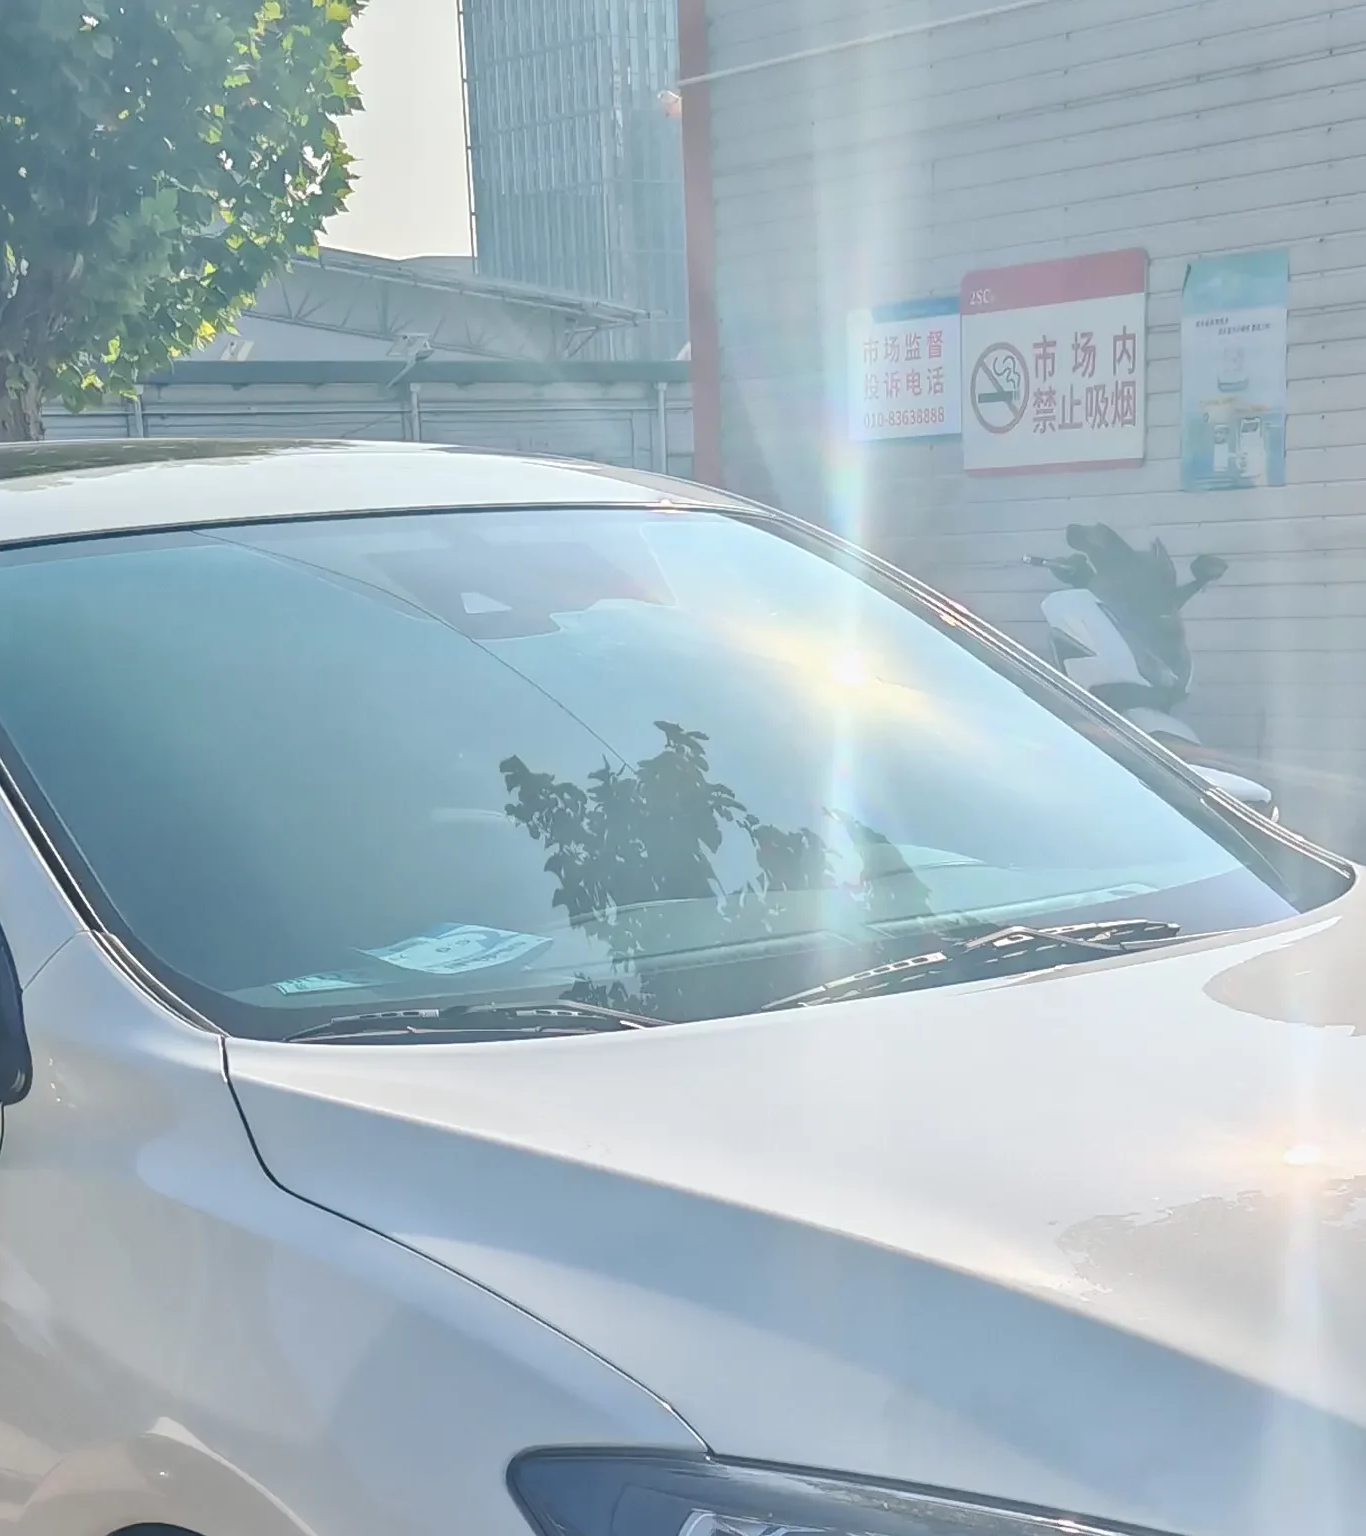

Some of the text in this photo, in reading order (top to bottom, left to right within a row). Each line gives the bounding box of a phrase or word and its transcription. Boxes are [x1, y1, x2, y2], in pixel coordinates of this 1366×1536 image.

[863, 330, 943, 365] 市场监督
[1032, 325, 1136, 383] 市场内
[864, 366, 944, 401] 投诉电话
[1032, 380, 1136, 434] 禁止吸烟
